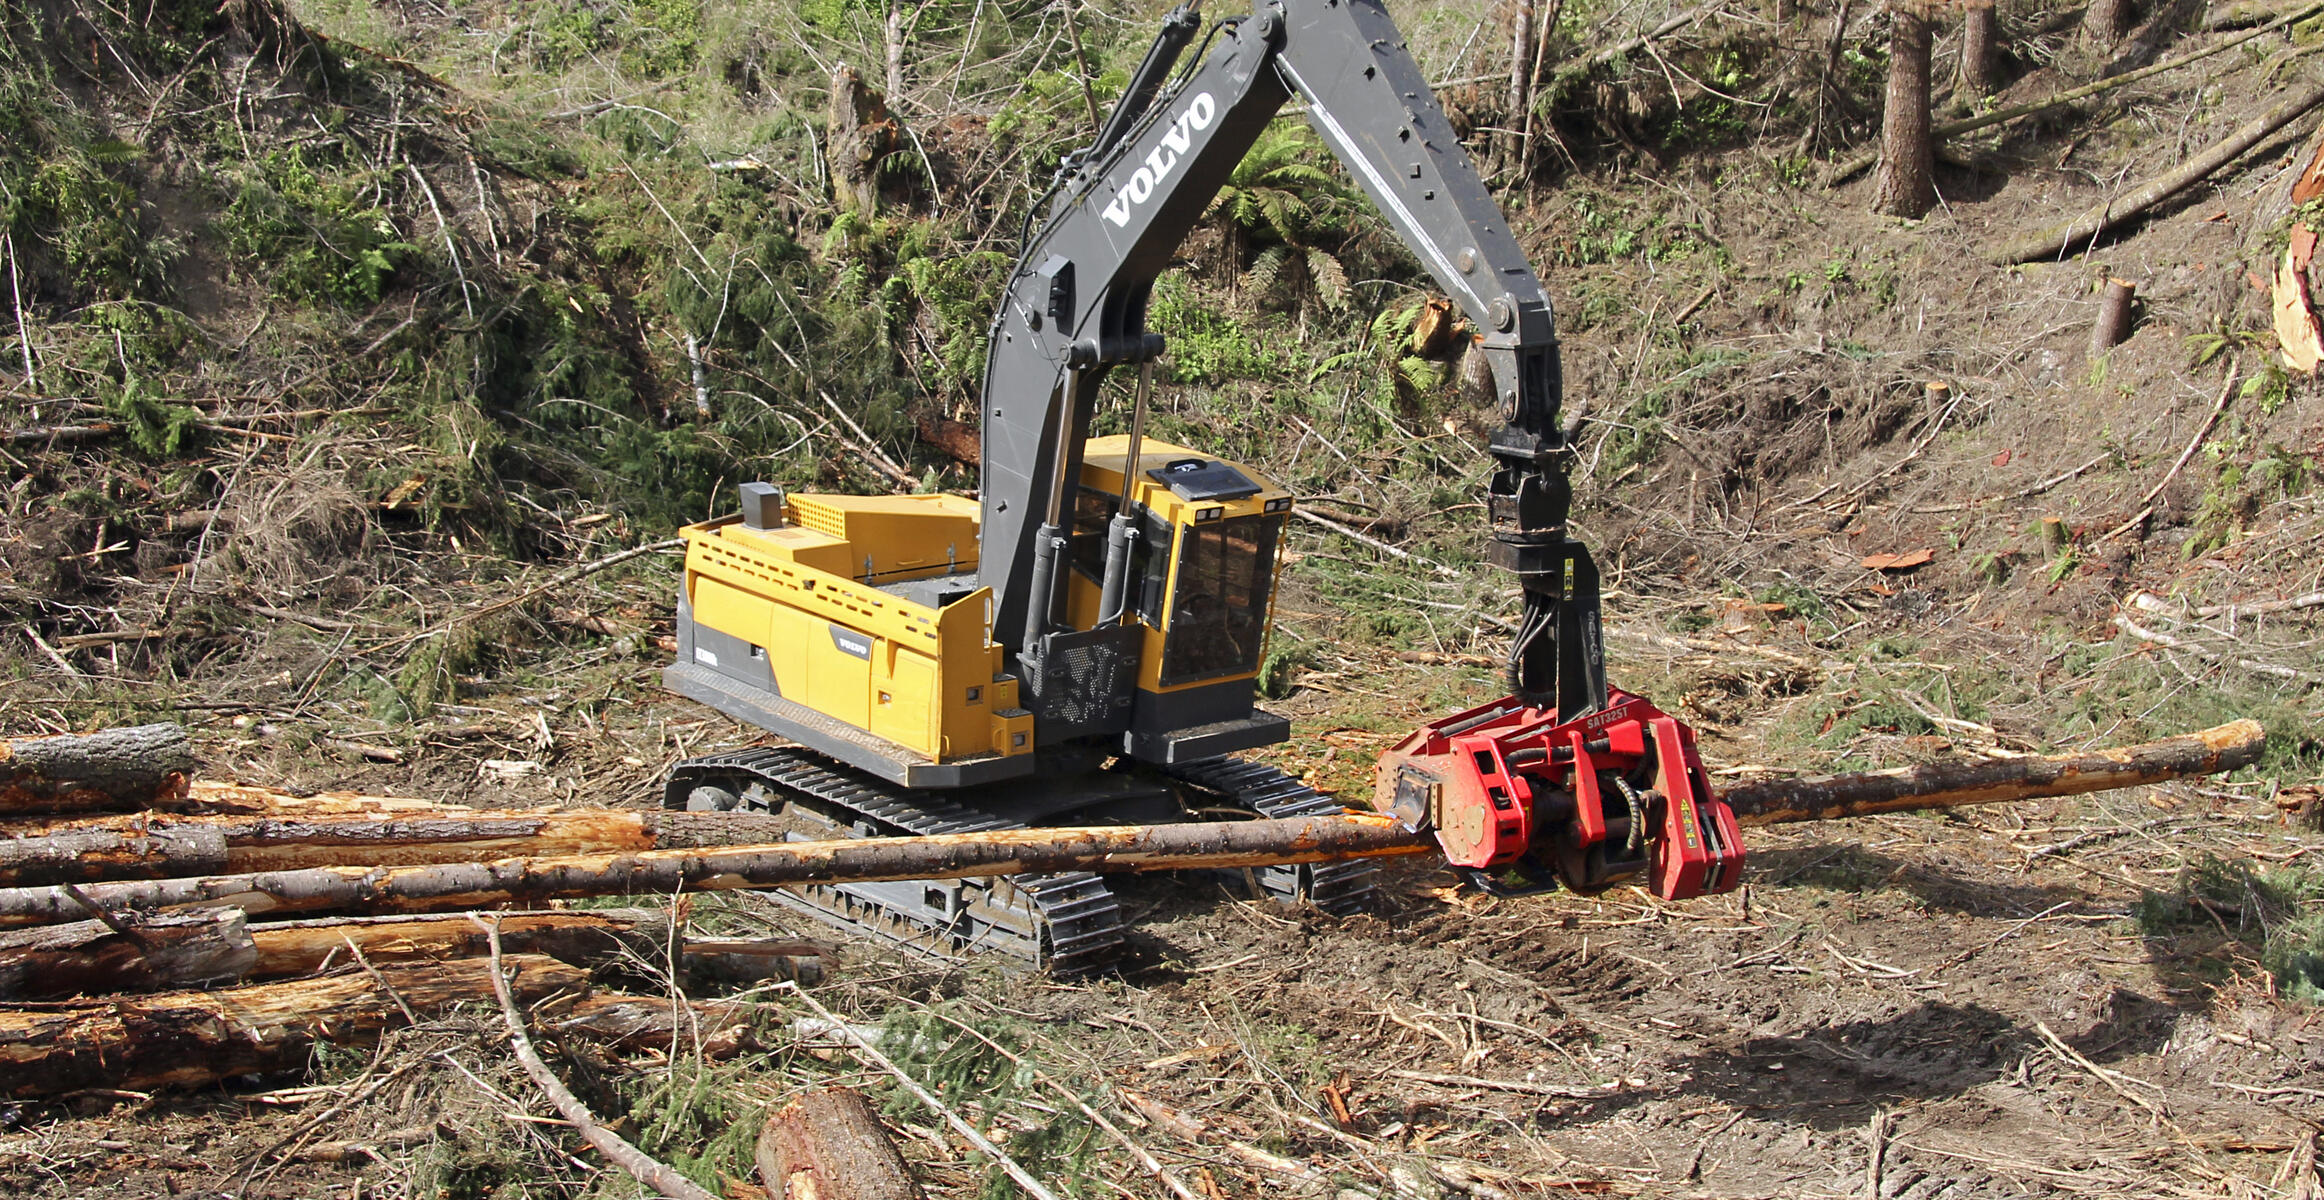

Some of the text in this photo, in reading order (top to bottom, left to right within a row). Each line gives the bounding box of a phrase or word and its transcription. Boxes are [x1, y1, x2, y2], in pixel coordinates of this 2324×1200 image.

[1101, 92, 1215, 228] VOLVO
[839, 637, 867, 655] VOLVO
[1586, 706, 1628, 729] SAT325T
